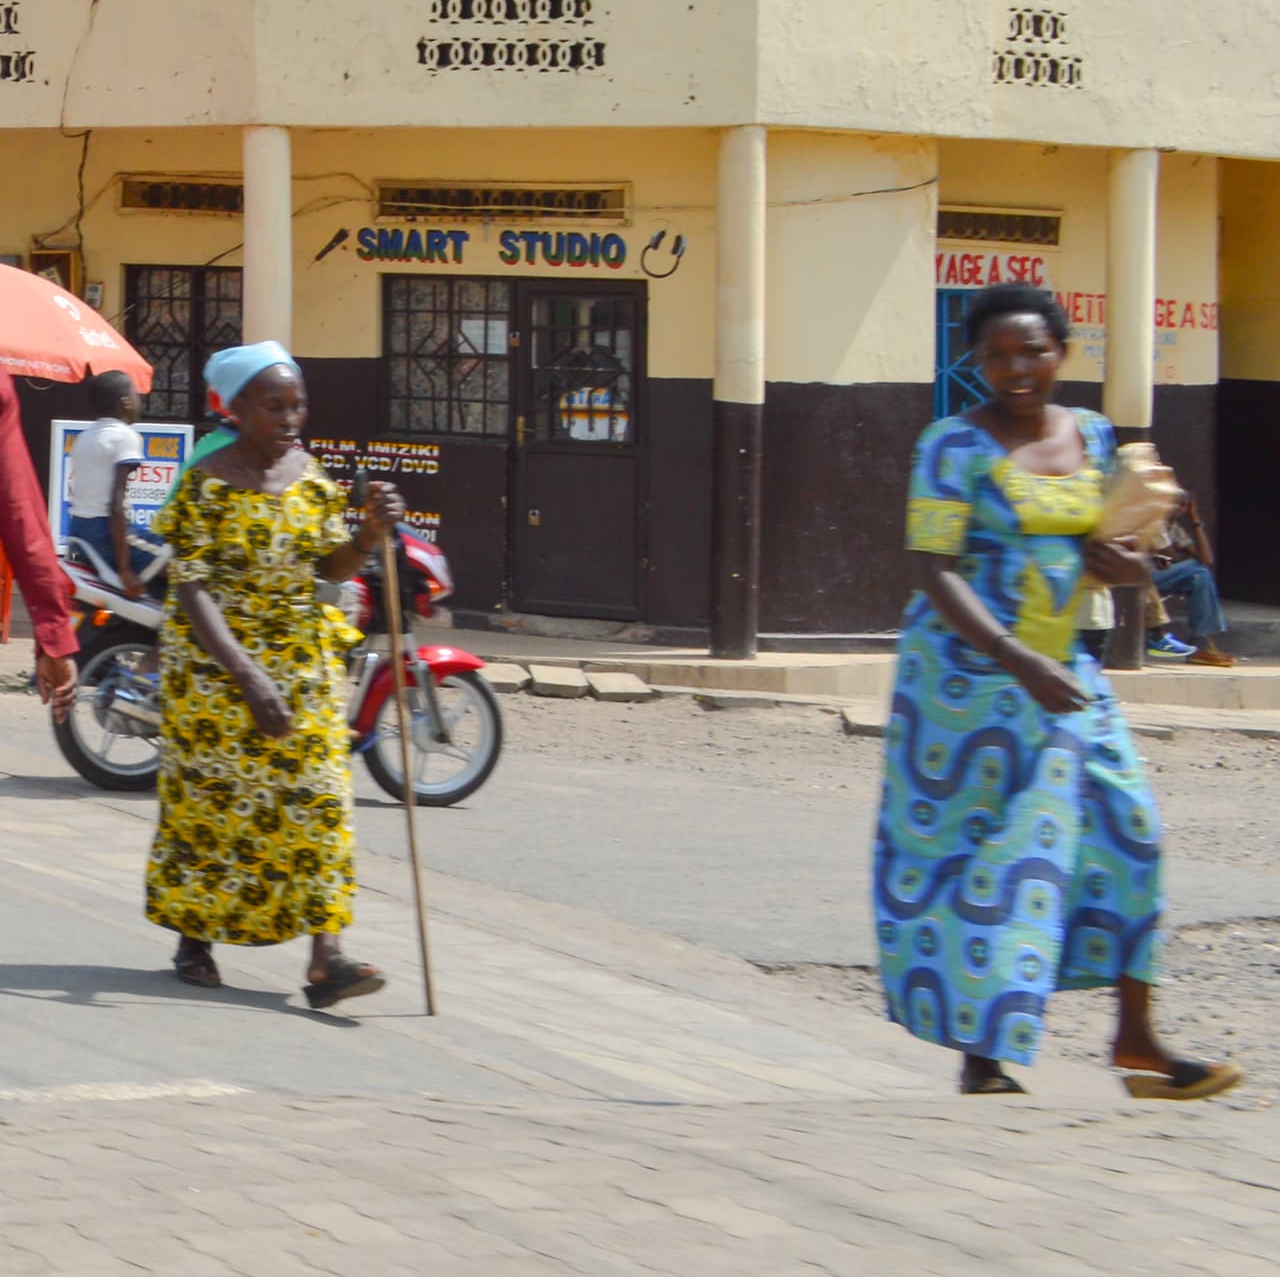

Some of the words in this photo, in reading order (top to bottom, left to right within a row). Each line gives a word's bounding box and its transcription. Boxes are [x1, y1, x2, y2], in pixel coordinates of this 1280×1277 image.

[356, 227, 470, 264] SMART
[499, 230, 627, 269] STUDIO
[988, 256, 1002, 284] A
[148, 436, 181, 459] HOUSE
[309, 438, 362, 453] FILM.
[367, 441, 440, 457] IMIZIKI
[354, 455, 440, 474] VCD/DVD
